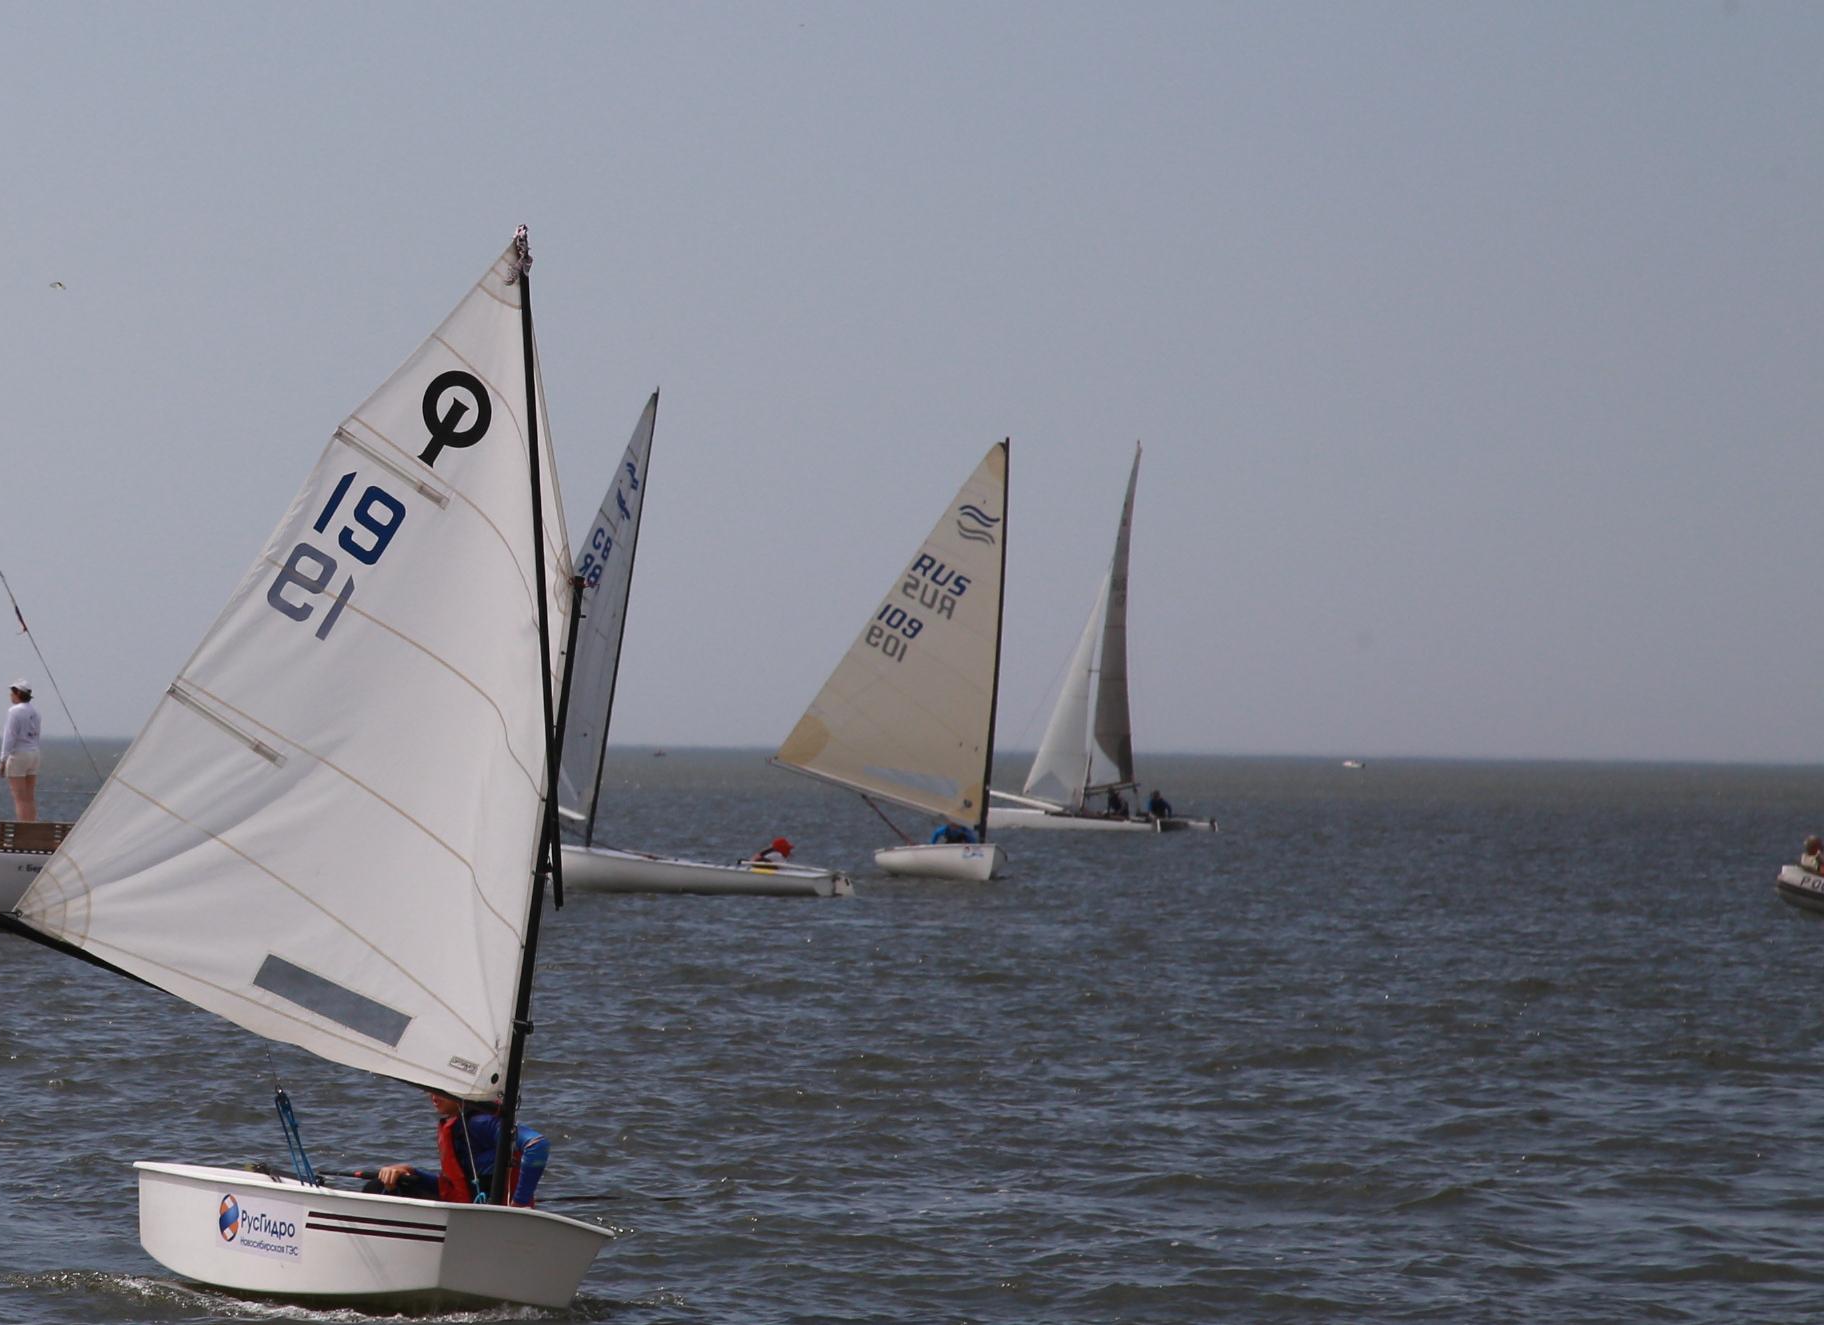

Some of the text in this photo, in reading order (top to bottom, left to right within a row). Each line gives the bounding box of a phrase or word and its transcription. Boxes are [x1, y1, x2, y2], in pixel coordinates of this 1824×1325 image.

[313, 471, 407, 566] 19
[592, 527, 613, 561] GB
[911, 553, 972, 597] RUS
[876, 603, 924, 640] 109
[240, 1209, 296, 1240] РусГидро
[285, 1244, 299, 1257] ГЭС
